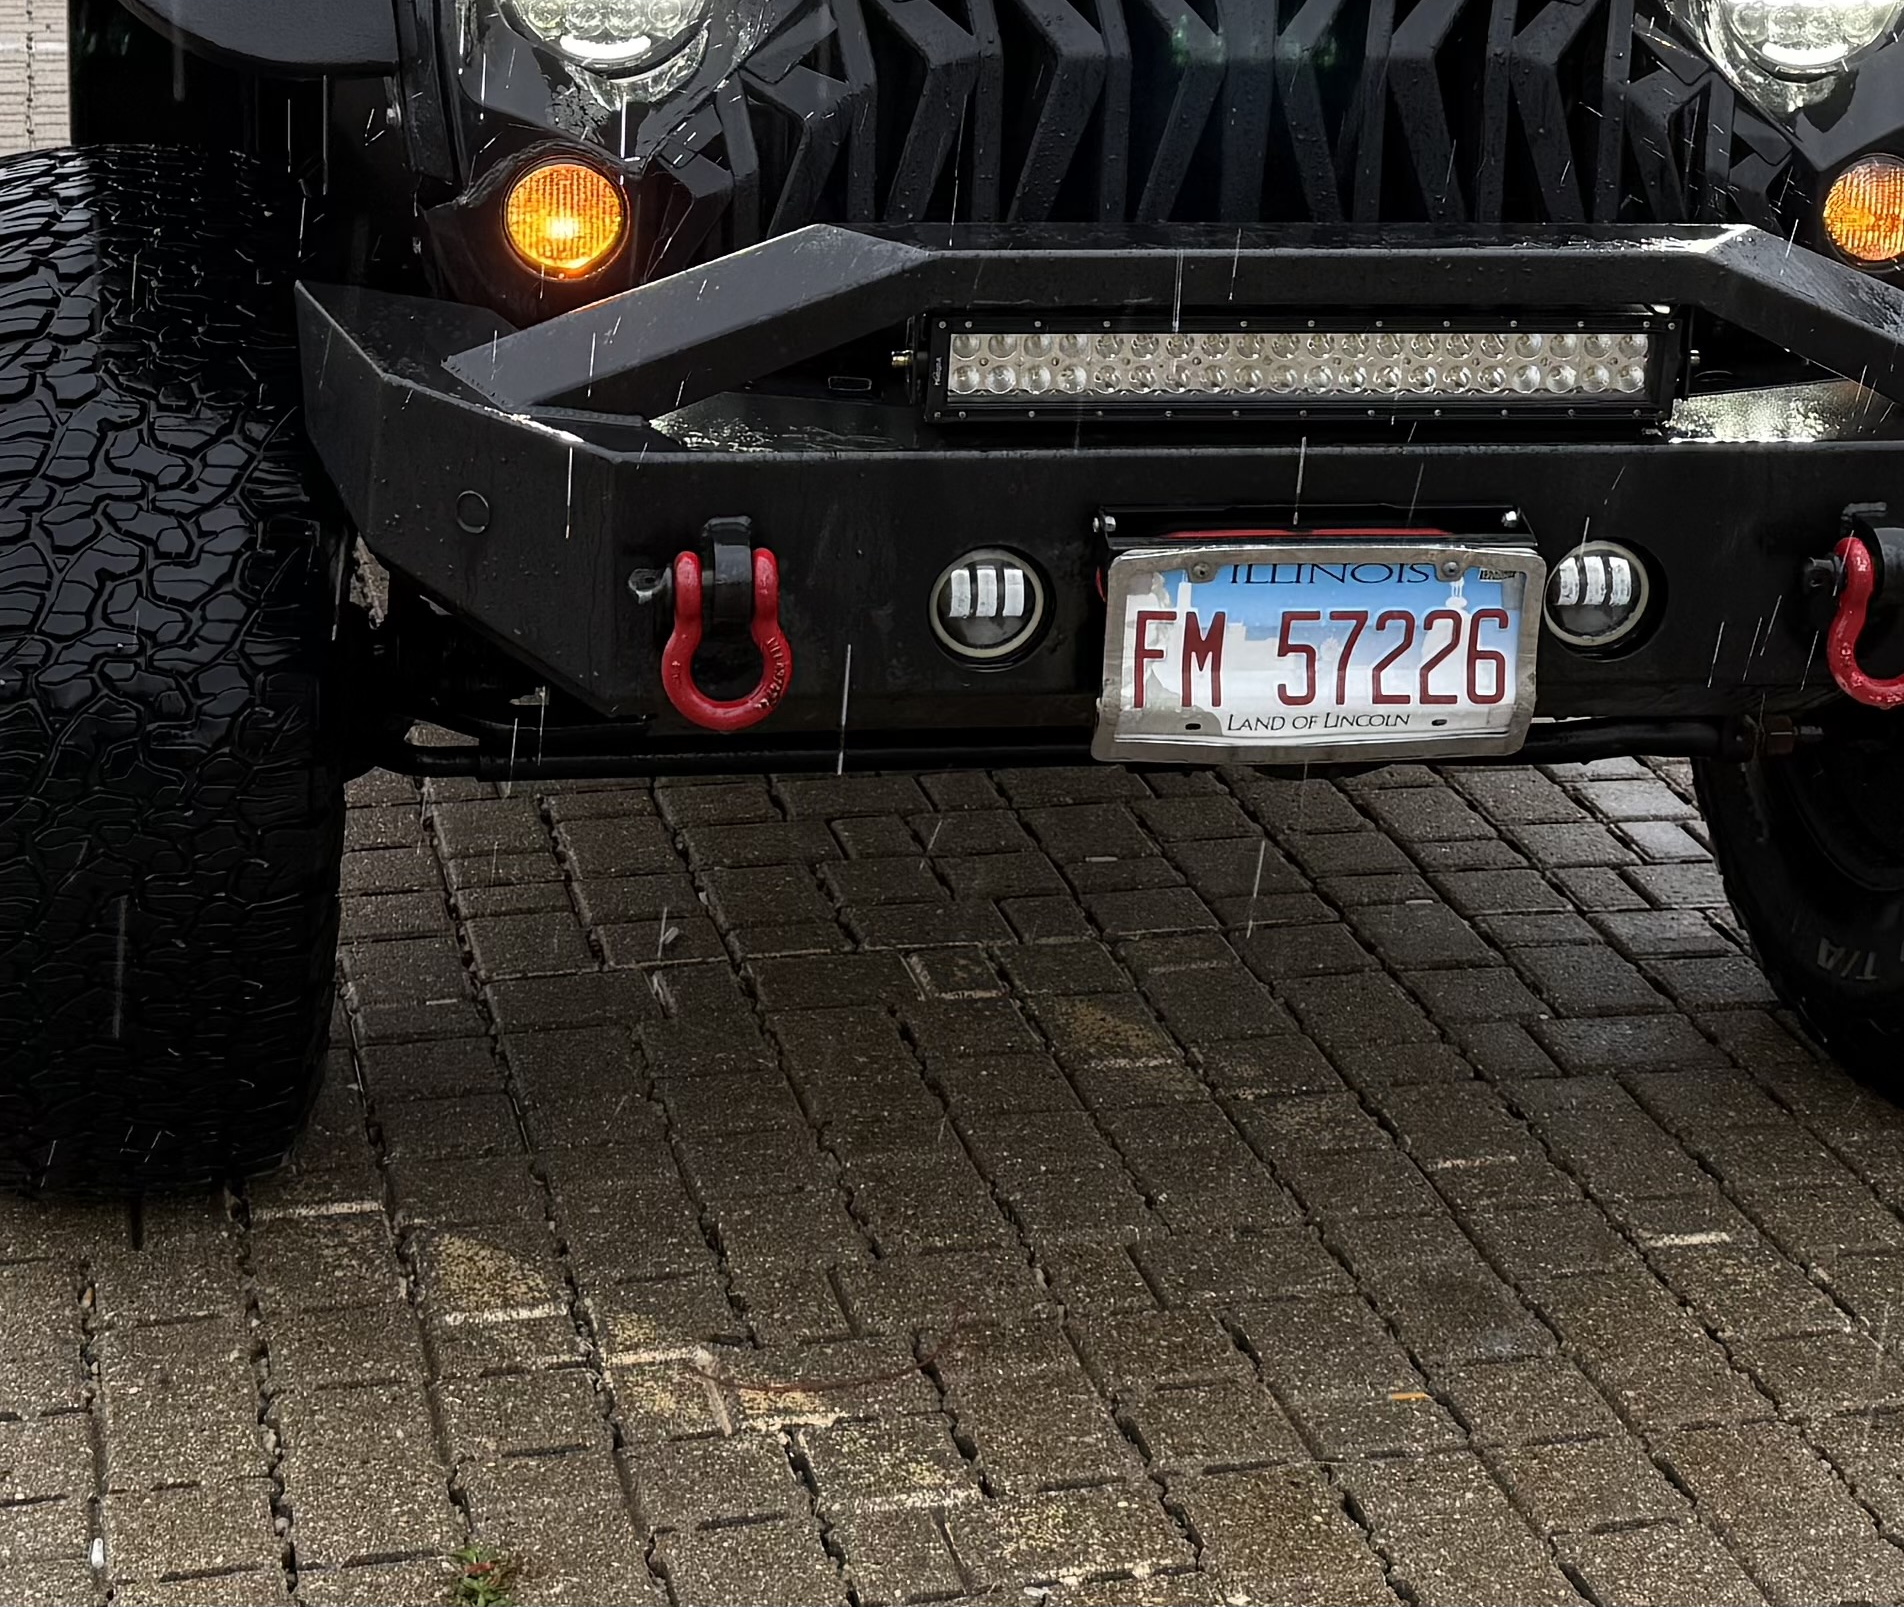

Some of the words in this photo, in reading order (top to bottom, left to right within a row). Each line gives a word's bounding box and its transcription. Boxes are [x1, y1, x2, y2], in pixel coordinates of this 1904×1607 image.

[1230, 562, 1430, 584] ILLINOIS
[1133, 609, 1226, 708] FM
[1276, 607, 1509, 706] 57226
[1227, 713, 1286, 731] LAND
[1292, 715, 1319, 730] OF
[1324, 711, 1411, 729] LINCOLN
